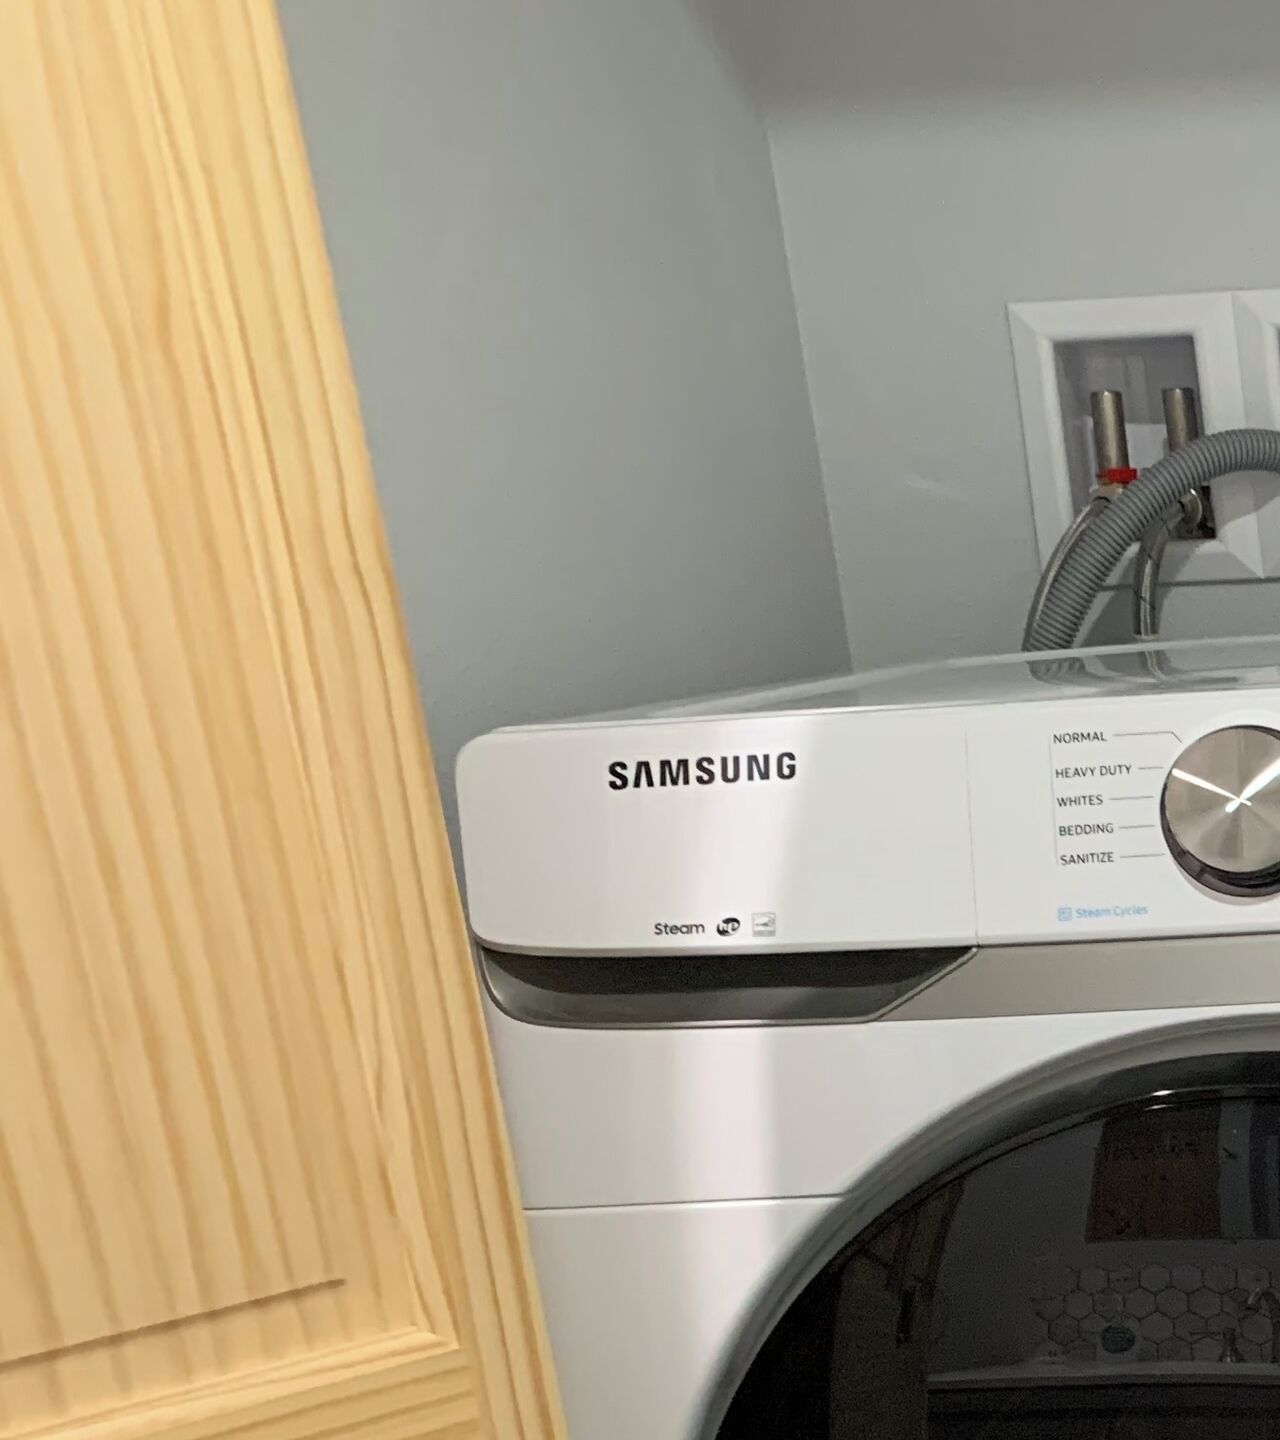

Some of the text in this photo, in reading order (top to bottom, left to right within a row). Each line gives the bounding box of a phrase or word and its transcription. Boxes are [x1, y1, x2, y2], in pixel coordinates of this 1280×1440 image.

[1053, 731, 1107, 744] NORMAL
[608, 751, 797, 791] SAMSUNG
[1055, 764, 1132, 779] HEAVY DUTY
[1056, 794, 1104, 808] WHITES
[1058, 823, 1115, 837] BEDDING
[1060, 851, 1115, 866] SANITIZE
[654, 922, 705, 936] Steam
